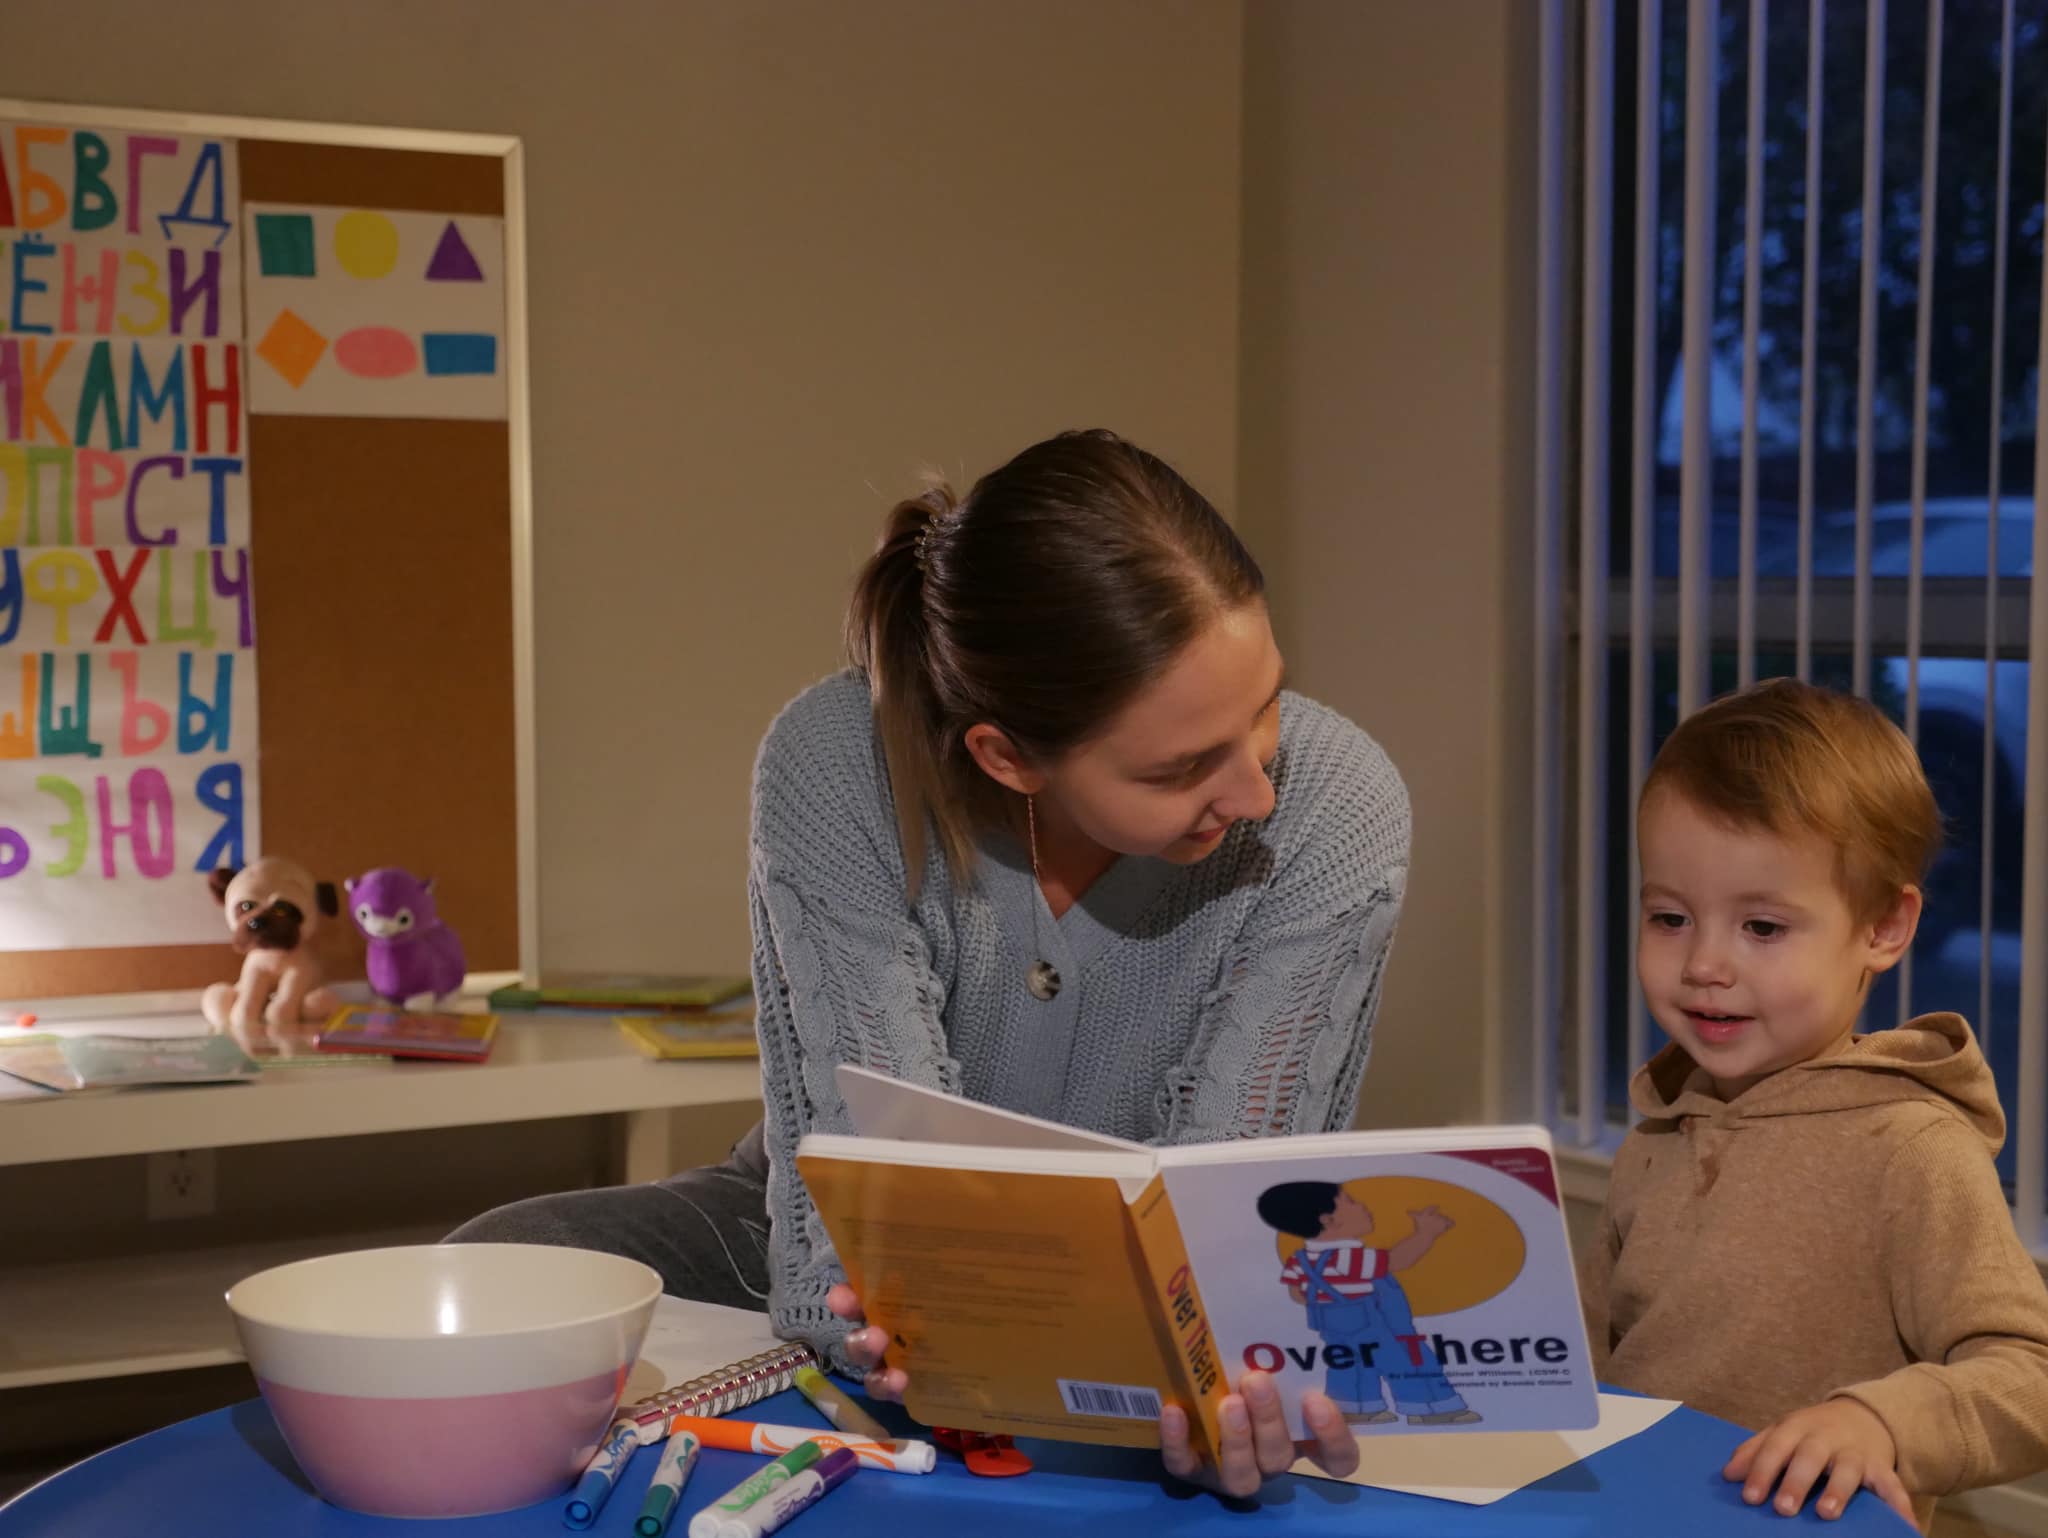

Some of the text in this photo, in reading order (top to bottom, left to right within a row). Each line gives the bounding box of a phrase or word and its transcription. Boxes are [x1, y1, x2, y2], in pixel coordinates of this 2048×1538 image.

[1167, 1264, 1217, 1396] Over There
[1242, 1334, 1569, 1374] Over There
